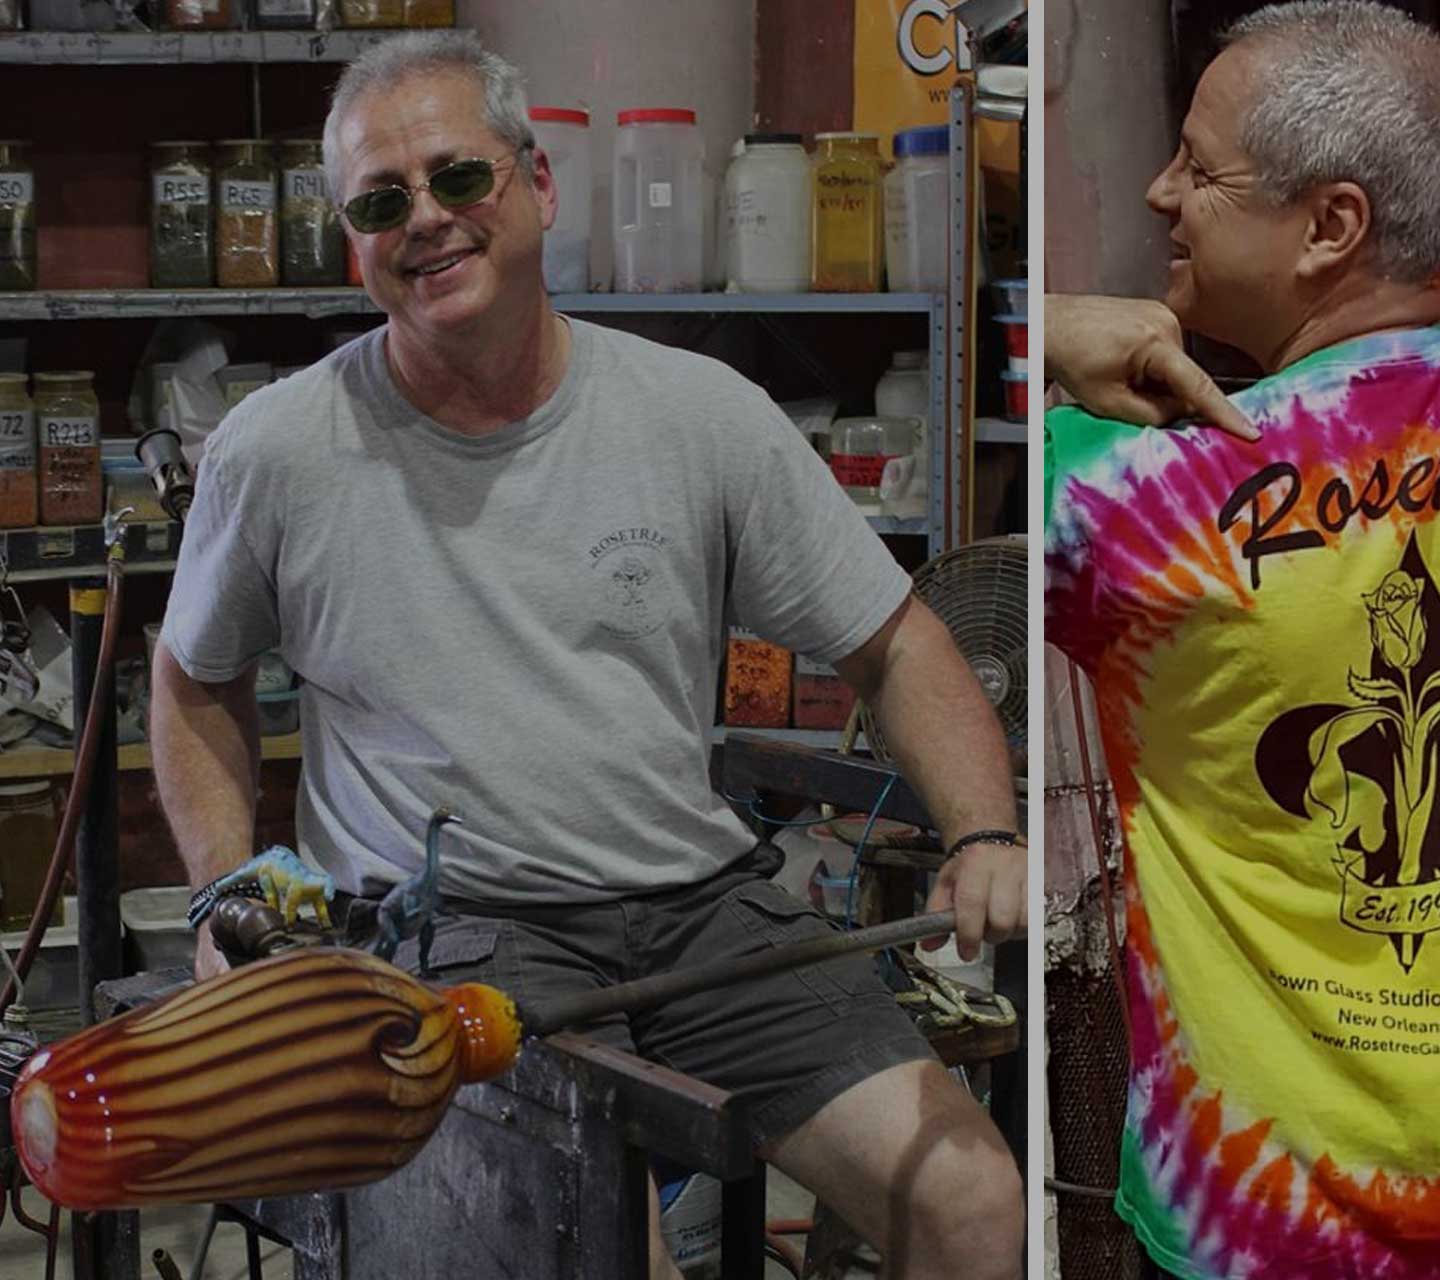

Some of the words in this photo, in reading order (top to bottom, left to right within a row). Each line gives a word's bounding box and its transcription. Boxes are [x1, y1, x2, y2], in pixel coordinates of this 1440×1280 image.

[1269, 968, 1319, 993] own
[1325, 980, 1374, 1004] Glass
[1338, 1008, 1377, 1028] New
